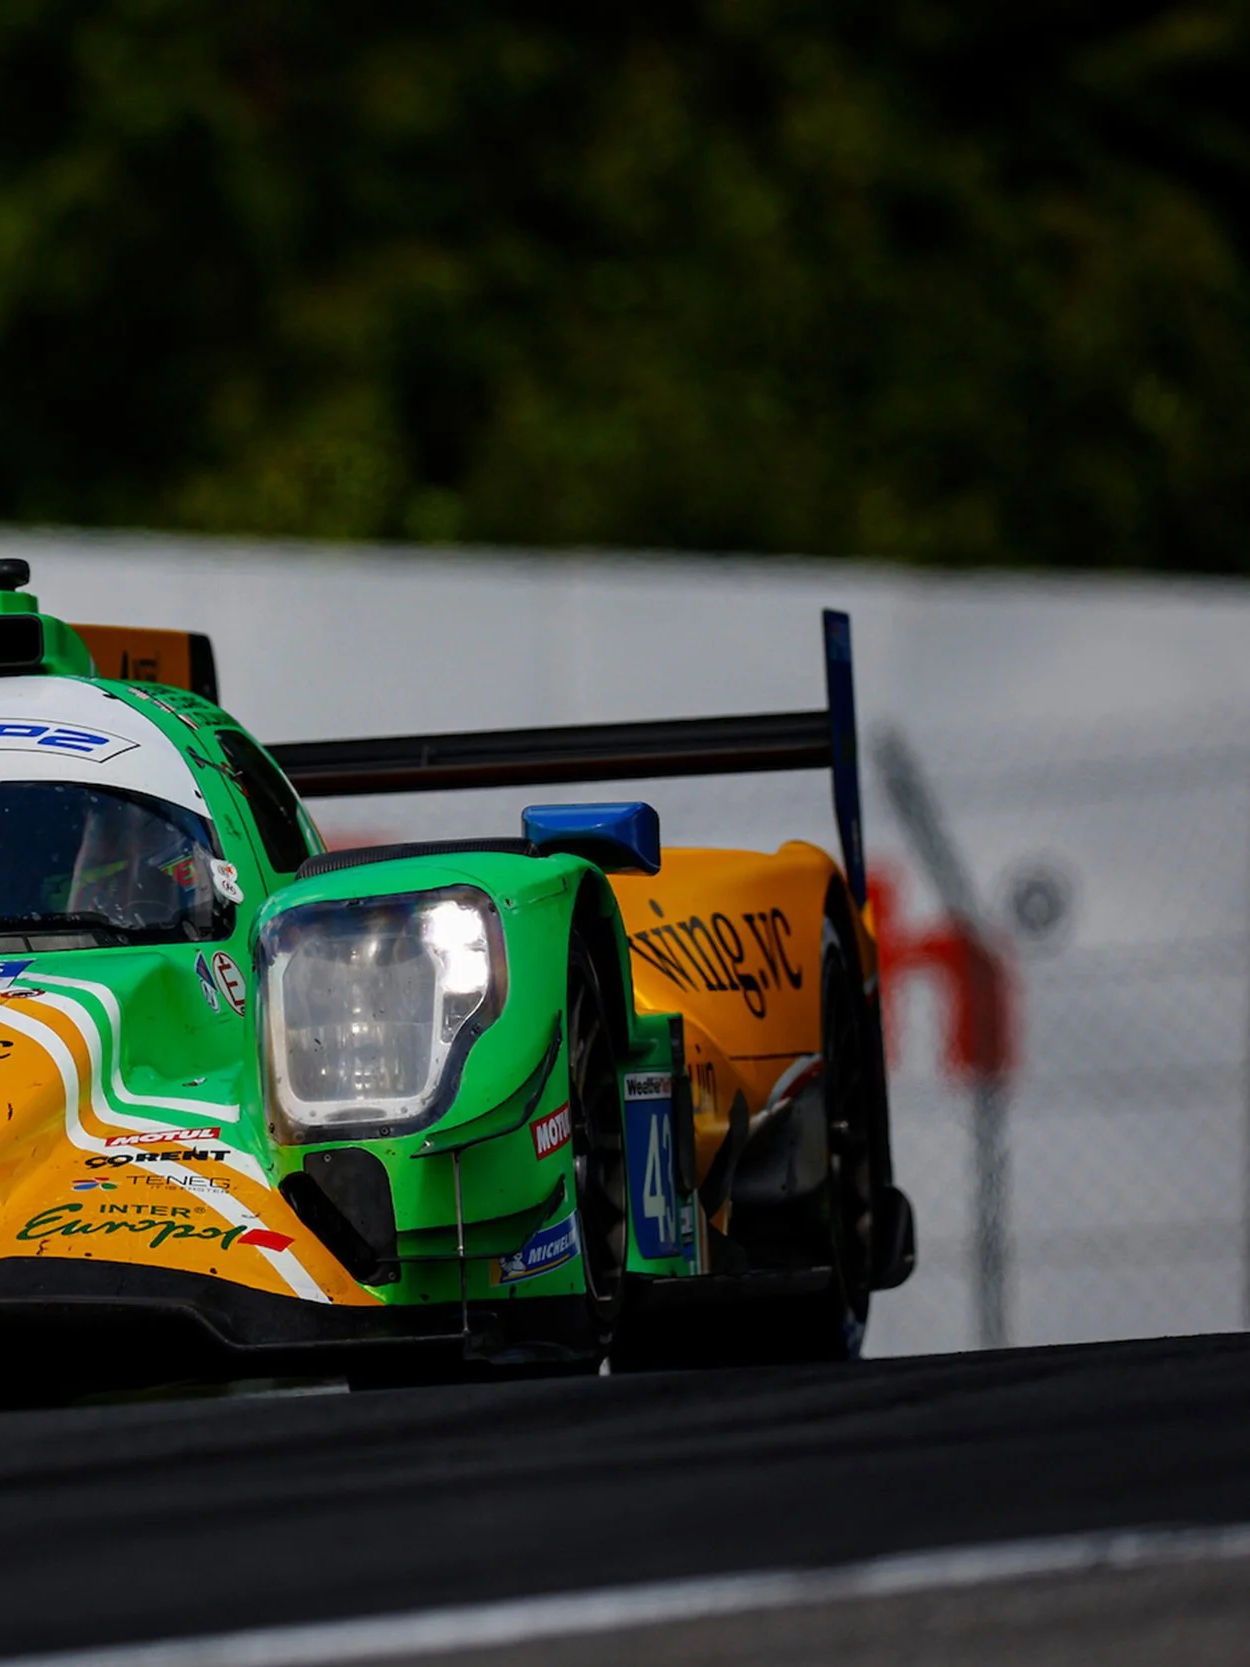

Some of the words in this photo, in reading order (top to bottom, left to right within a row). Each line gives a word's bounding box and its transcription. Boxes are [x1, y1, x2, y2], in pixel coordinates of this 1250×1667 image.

[626, 898, 803, 1019] wing.vc
[111, 1128, 215, 1146] MOTUL
[126, 1175, 231, 1190] TENEG
[100, 1203, 191, 1219] INTER
[16, 1203, 248, 1250] Europol
